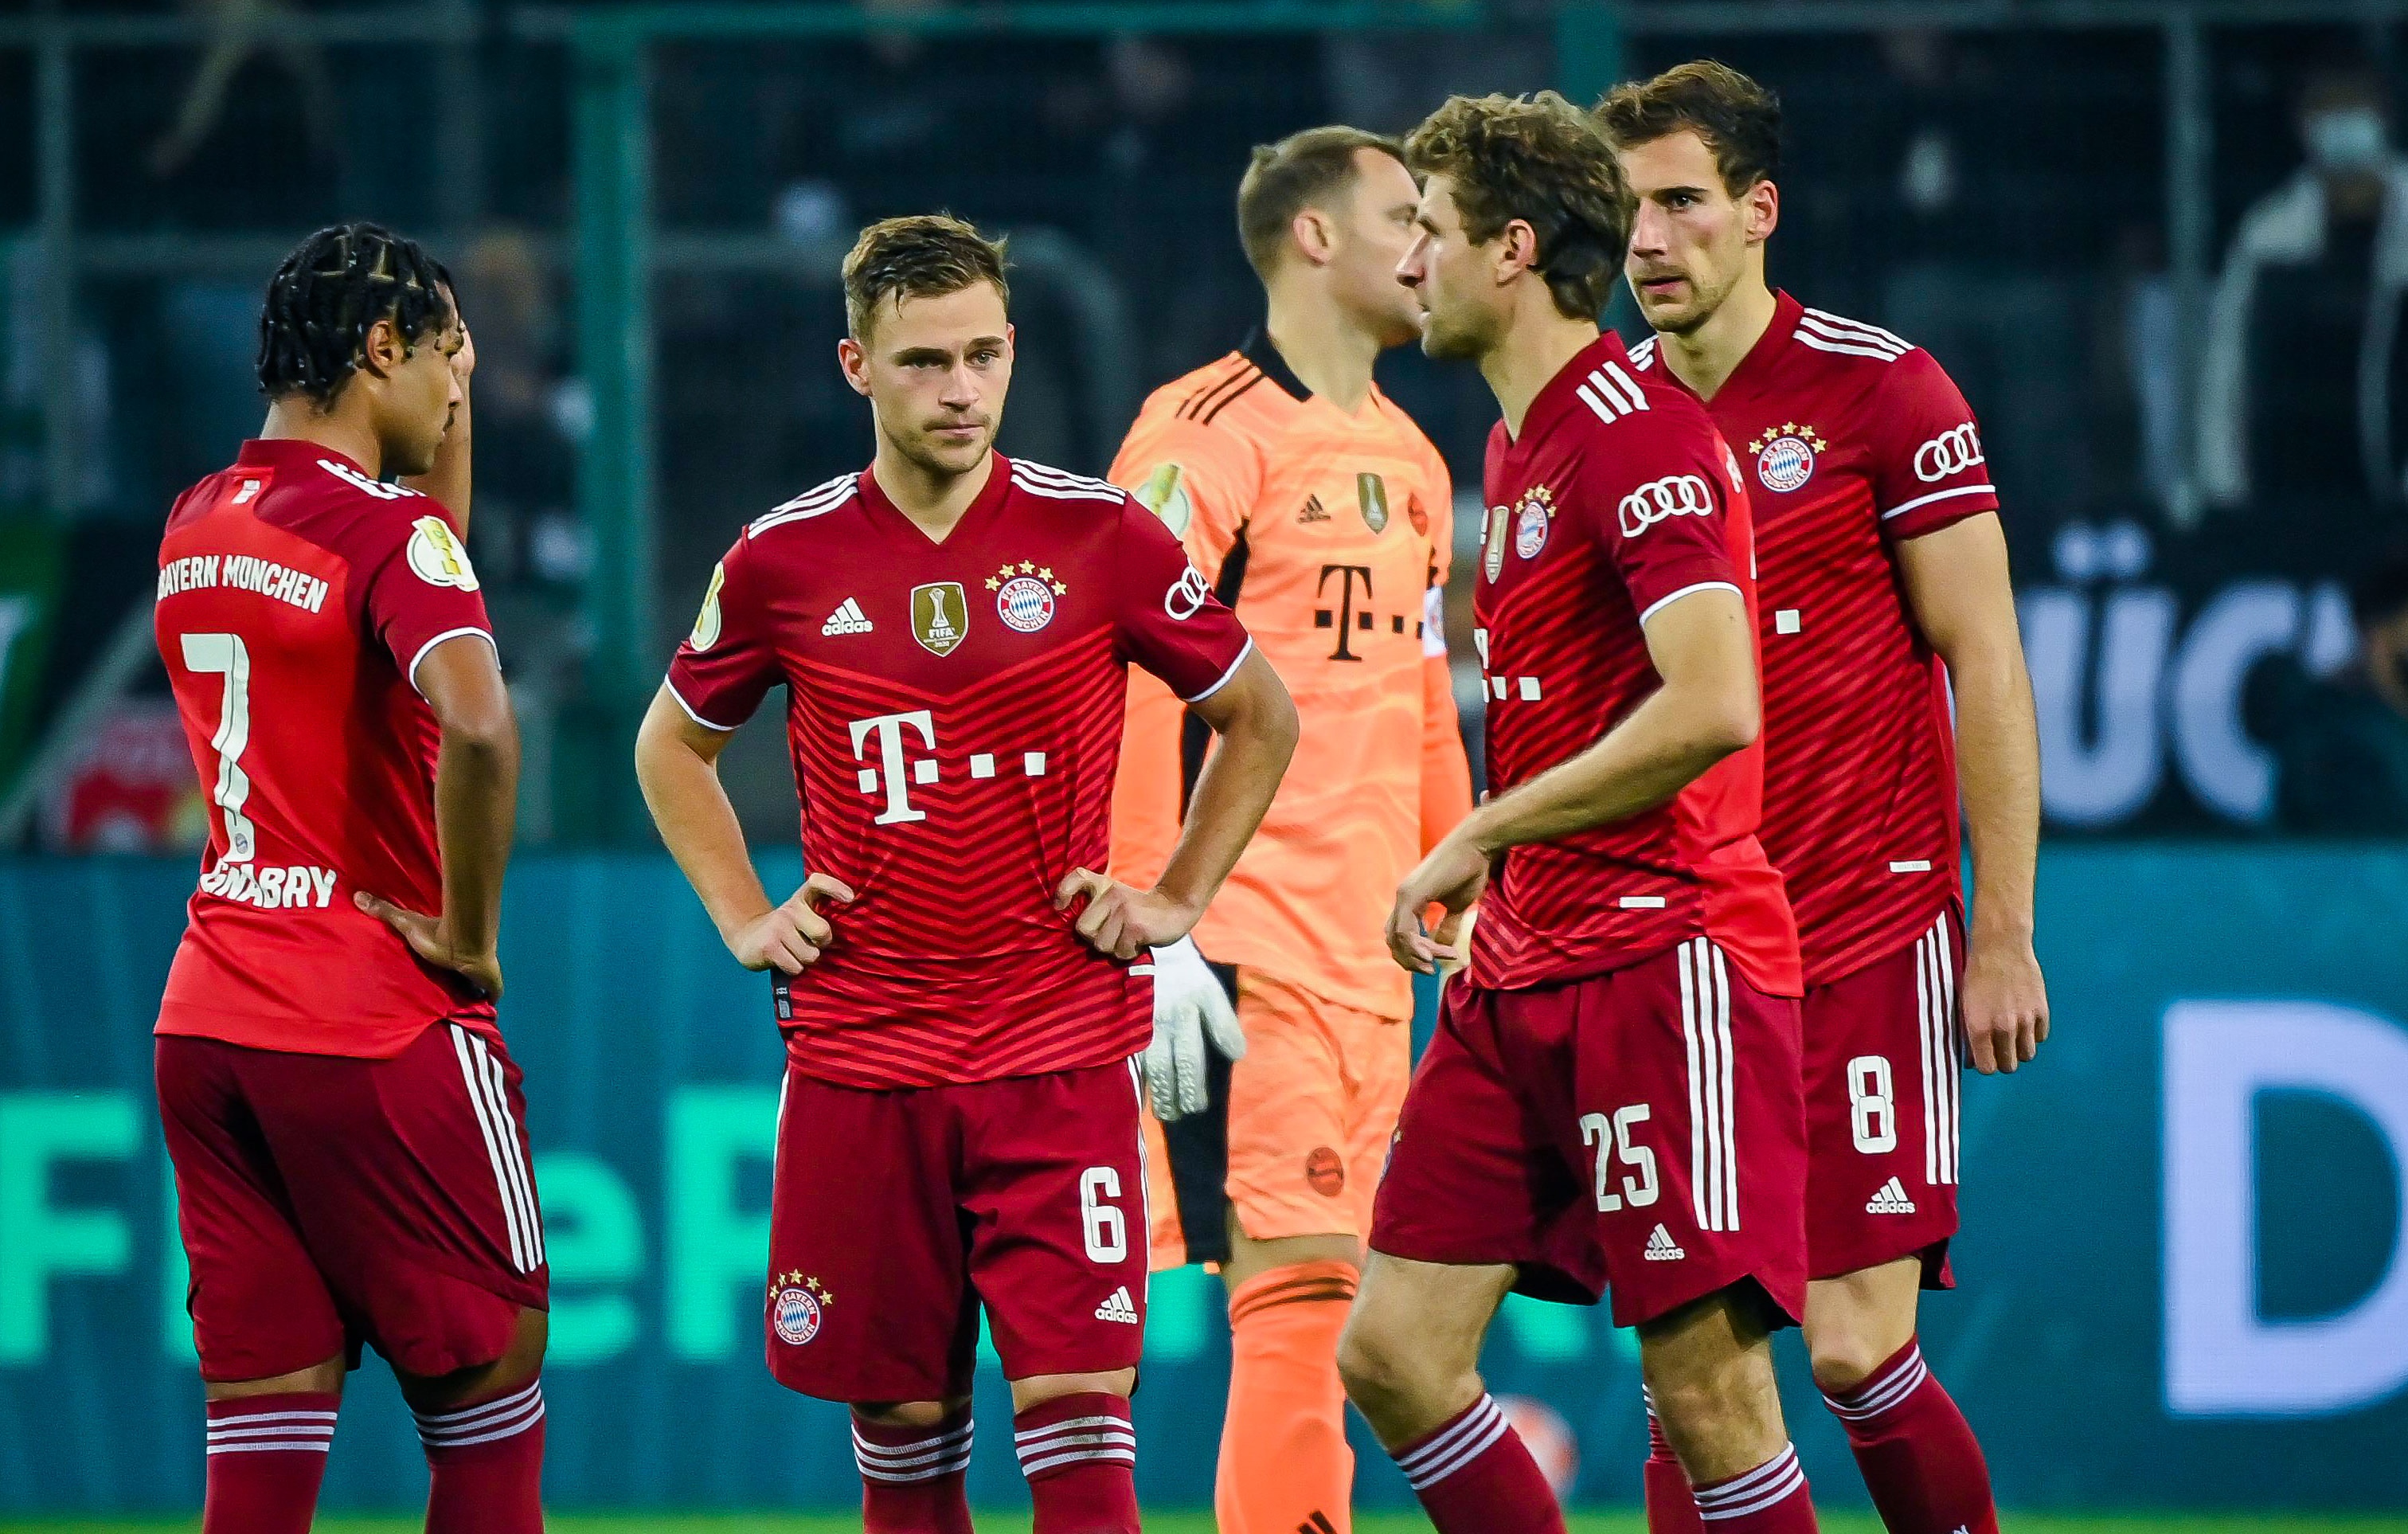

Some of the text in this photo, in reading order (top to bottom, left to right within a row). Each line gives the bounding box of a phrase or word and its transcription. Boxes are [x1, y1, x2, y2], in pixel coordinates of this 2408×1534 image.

[821, 620, 874, 636] adidas
[928, 627, 956, 639] FIFA
[180, 633, 256, 863] 7
[199, 858, 338, 909] GNABRY
[1847, 1055, 1898, 1153] 8
[1580, 1103, 1659, 1212] 25
[1079, 1166, 1128, 1263] 6
[1866, 1199, 1916, 1214] adidas
[1644, 1246, 1686, 1261] adidas
[1094, 1307, 1138, 1325] adidas
